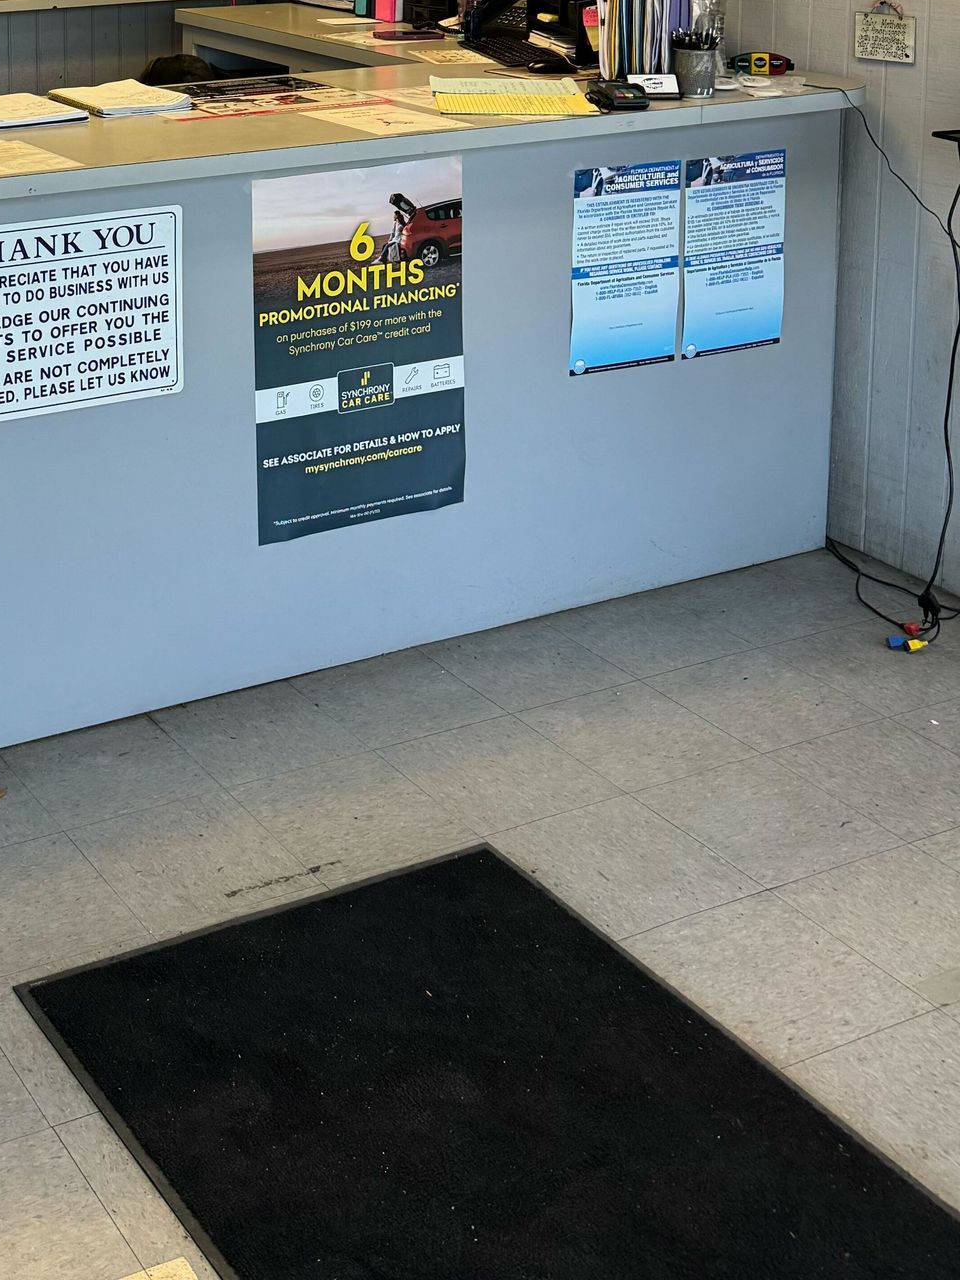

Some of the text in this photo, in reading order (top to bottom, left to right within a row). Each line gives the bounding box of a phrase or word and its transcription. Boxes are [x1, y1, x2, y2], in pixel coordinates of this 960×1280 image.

[606, 178, 679, 192] CONSUMER SERVICES
[617, 170, 679, 183] AGRICULTURE and
[92, 222, 156, 250] YOU
[349, 222, 375, 262] 6
[62, 263, 97, 280] THAT
[102, 259, 130, 274] YOU
[134, 254, 169, 270] HAVE
[297, 258, 425, 301] MONTHS
[3, 292, 21, 306] TO
[26, 289, 45, 303] DO
[49, 279, 113, 298] BUSINESS
[117, 274, 149, 289] WITH
[152, 271, 169, 284] US
[39, 308, 70, 323] OUR
[76, 294, 170, 318] CONTINUING
[259, 298, 370, 327] PROMOTIONAL
[22, 329, 42, 343] TO
[50, 321, 98, 340] OFFER
[105, 316, 135, 331] YOU
[142, 310, 170, 326] THE
[276, 309, 442, 343] on purchases of $199 or more with the
[289, 339, 336, 356] Synchrony
[338, 337, 354, 347] Car
[384, 328, 410, 339] credit
[411, 323, 431, 334] card
[6, 341, 76, 363] SERVICE
[84, 329, 162, 352] POSSIBLE
[3, 370, 33, 386] ARE
[40, 364, 72, 379] NOT
[78, 348, 170, 374] COMPLETELY
[24, 380, 76, 401] PLEASE
[80, 375, 104, 391] LET
[108, 372, 126, 386] US
[130, 365, 170, 383] KNOW
[341, 383, 390, 401] SYNCHRONY
[402, 379, 456, 393] REPAIRS BATTERIES
[310, 402, 324, 410] TIRES
[342, 392, 391, 409] CAR CARE
[263, 423, 461, 469] SEE ASSOCIATE FOR DETAILS & HOW TO APPLY
[305, 444, 423, 475] mysynchrony.com/carcare
